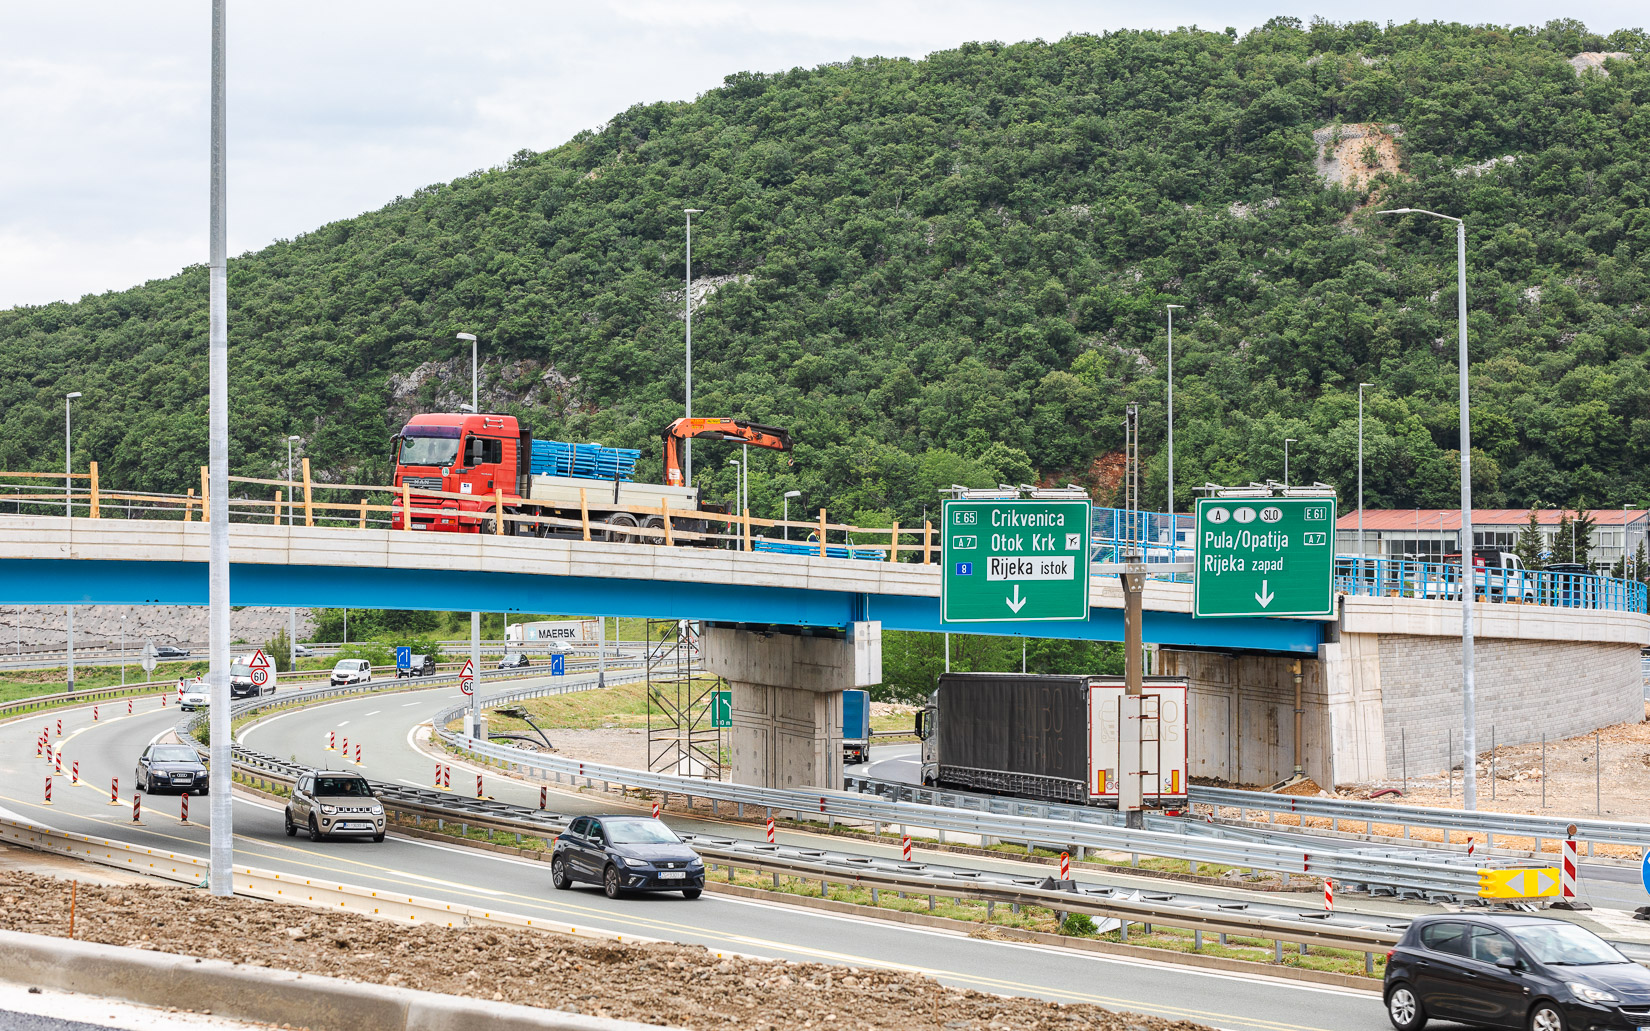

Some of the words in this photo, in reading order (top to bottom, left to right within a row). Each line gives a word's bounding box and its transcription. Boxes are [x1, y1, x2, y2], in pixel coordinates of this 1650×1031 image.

[414, 476, 430, 485] MAN
[956, 513, 961, 523] E
[963, 512, 975, 523] 65
[991, 509, 1065, 527] Crikvenica
[1215, 511, 1221, 521] A
[1263, 510, 1279, 521] SLO
[1306, 510, 1311, 519] E
[1313, 510, 1323, 519] 61
[958, 539, 963, 547] A
[966, 538, 971, 547] 7
[991, 533, 1024, 551] Otok
[1032, 533, 1056, 551] Krk
[1205, 530, 1289, 552] Pula/Opatija
[1316, 535, 1321, 543] 7
[962, 565, 967, 573] 8
[991, 558, 1033, 580] Rijeka
[1040, 560, 1068, 575] istok
[1204, 554, 1245, 576] Rijeka
[1251, 556, 1283, 574] zapad
[538, 628, 576, 639] MAERSK
[254, 672, 265, 682] 60
